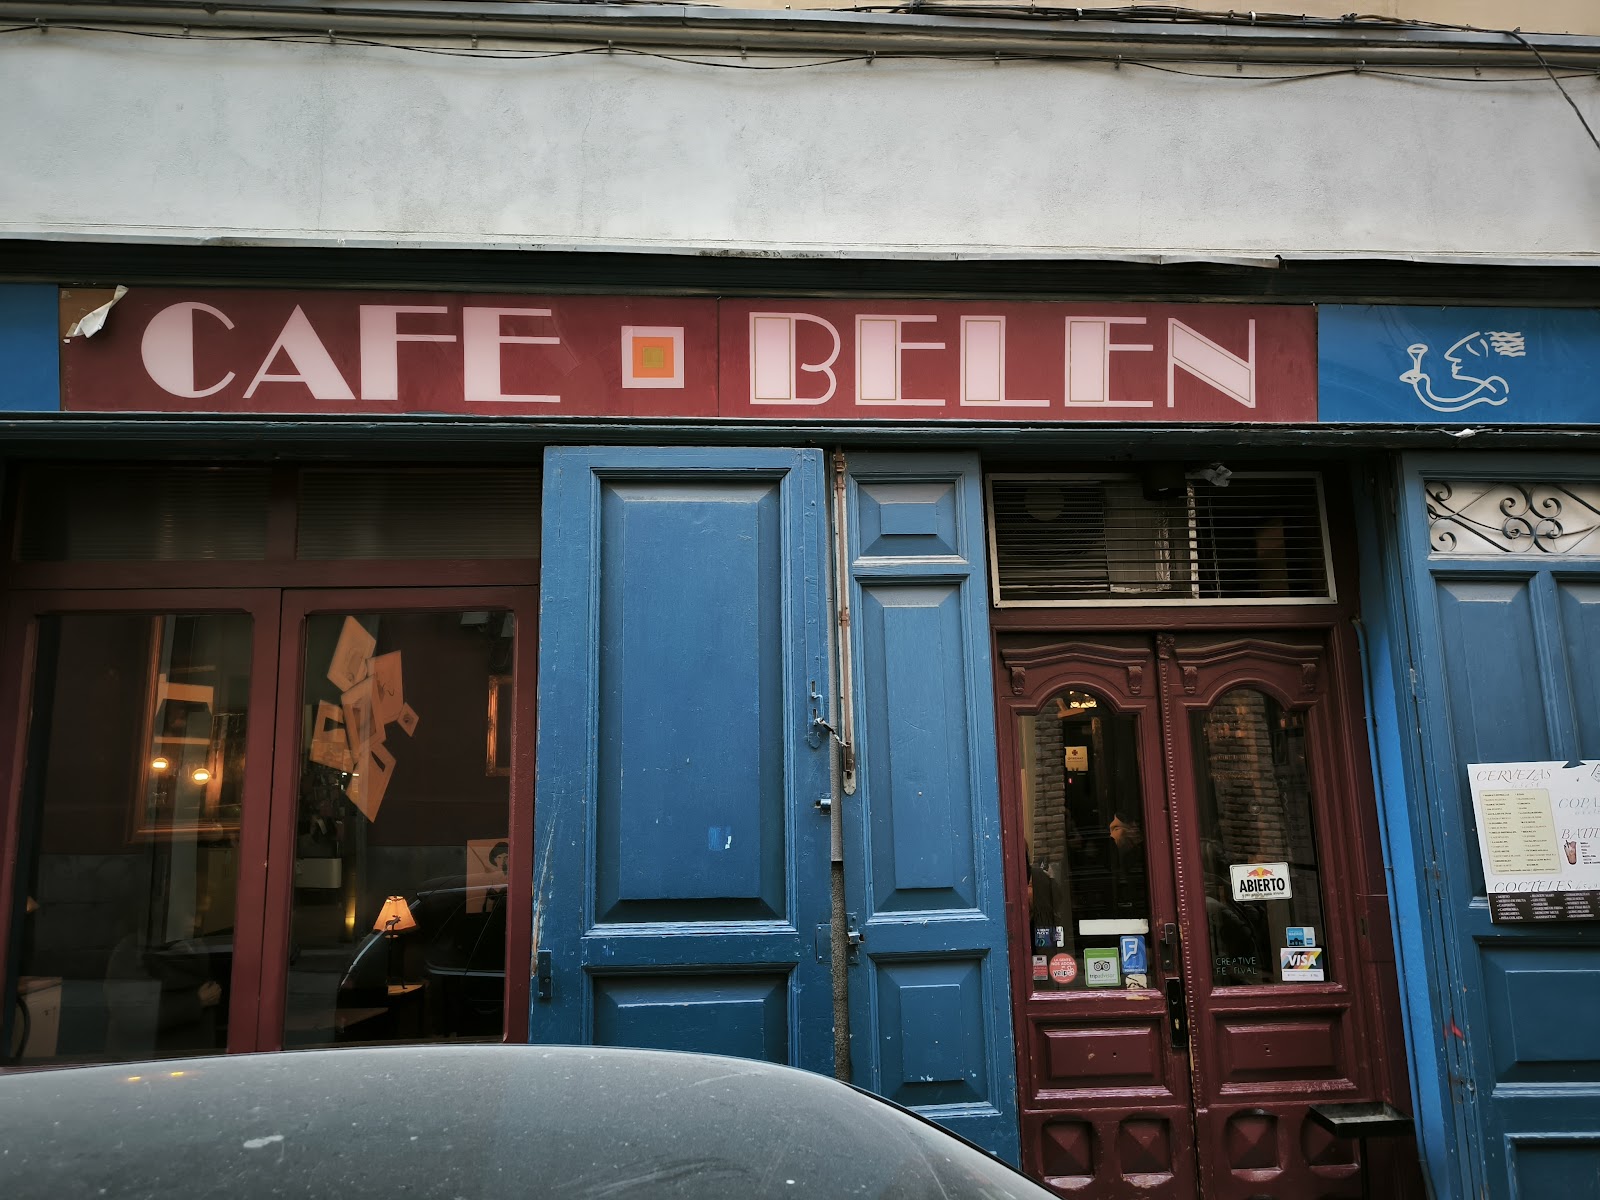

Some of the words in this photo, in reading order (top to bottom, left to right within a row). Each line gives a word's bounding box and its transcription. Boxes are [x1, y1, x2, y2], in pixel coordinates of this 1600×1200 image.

[141, 301, 561, 404] CAFE
[748, 311, 1256, 409] BELEN
[1476, 768, 1552, 783] CERVEZAS
[1558, 797, 1600, 809] COPA
[1240, 878, 1285, 893] ABIERTO
[1494, 879, 1573, 893] COCTELES
[1215, 956, 1257, 966] CREATIVE
[1287, 954, 1317, 966] VISA
[1216, 966, 1258, 976] FETIVAL
